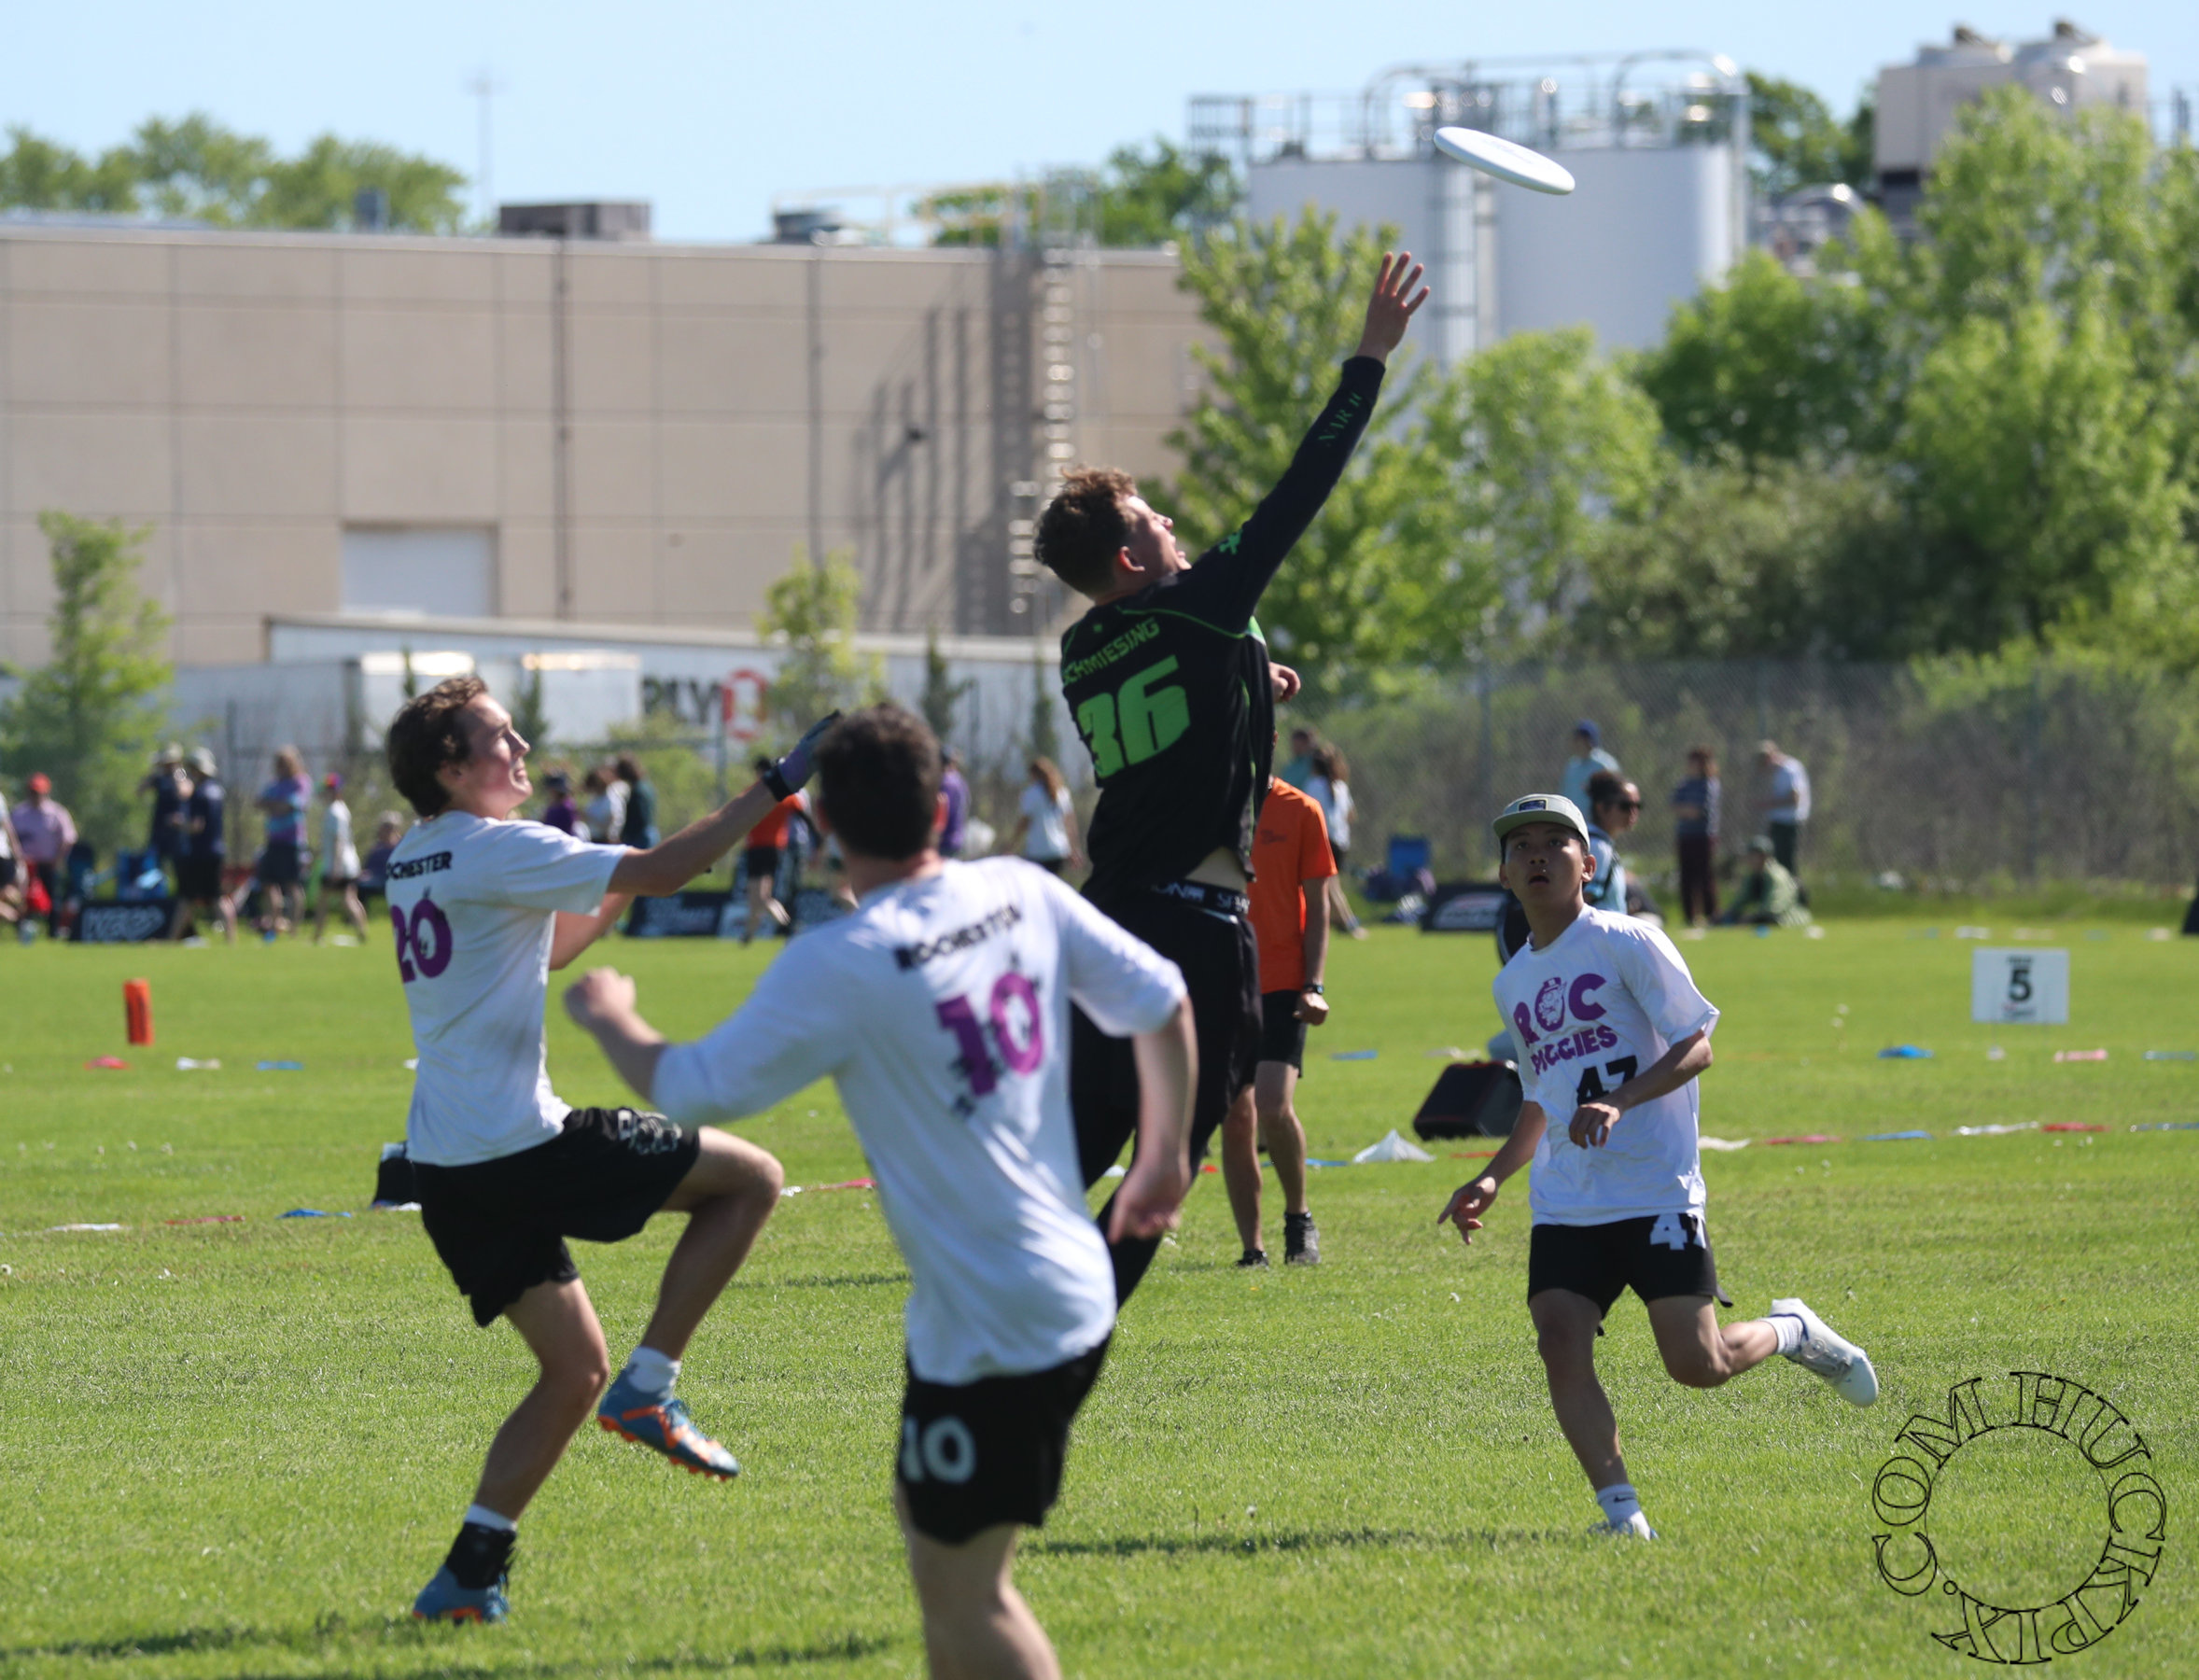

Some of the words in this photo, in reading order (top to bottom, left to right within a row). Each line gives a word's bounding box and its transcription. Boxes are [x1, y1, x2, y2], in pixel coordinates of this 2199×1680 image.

[1077, 654, 1191, 778] 36
[390, 898, 453, 984] 20
[1513, 973, 1607, 1048] ROC
[2008, 968, 2032, 1001] 5
[936, 971, 1043, 1098] 10
[1530, 1025, 1618, 1075] PIGGIES
[1576, 1056, 1638, 1106] 47
[902, 1415, 976, 1483] 10
